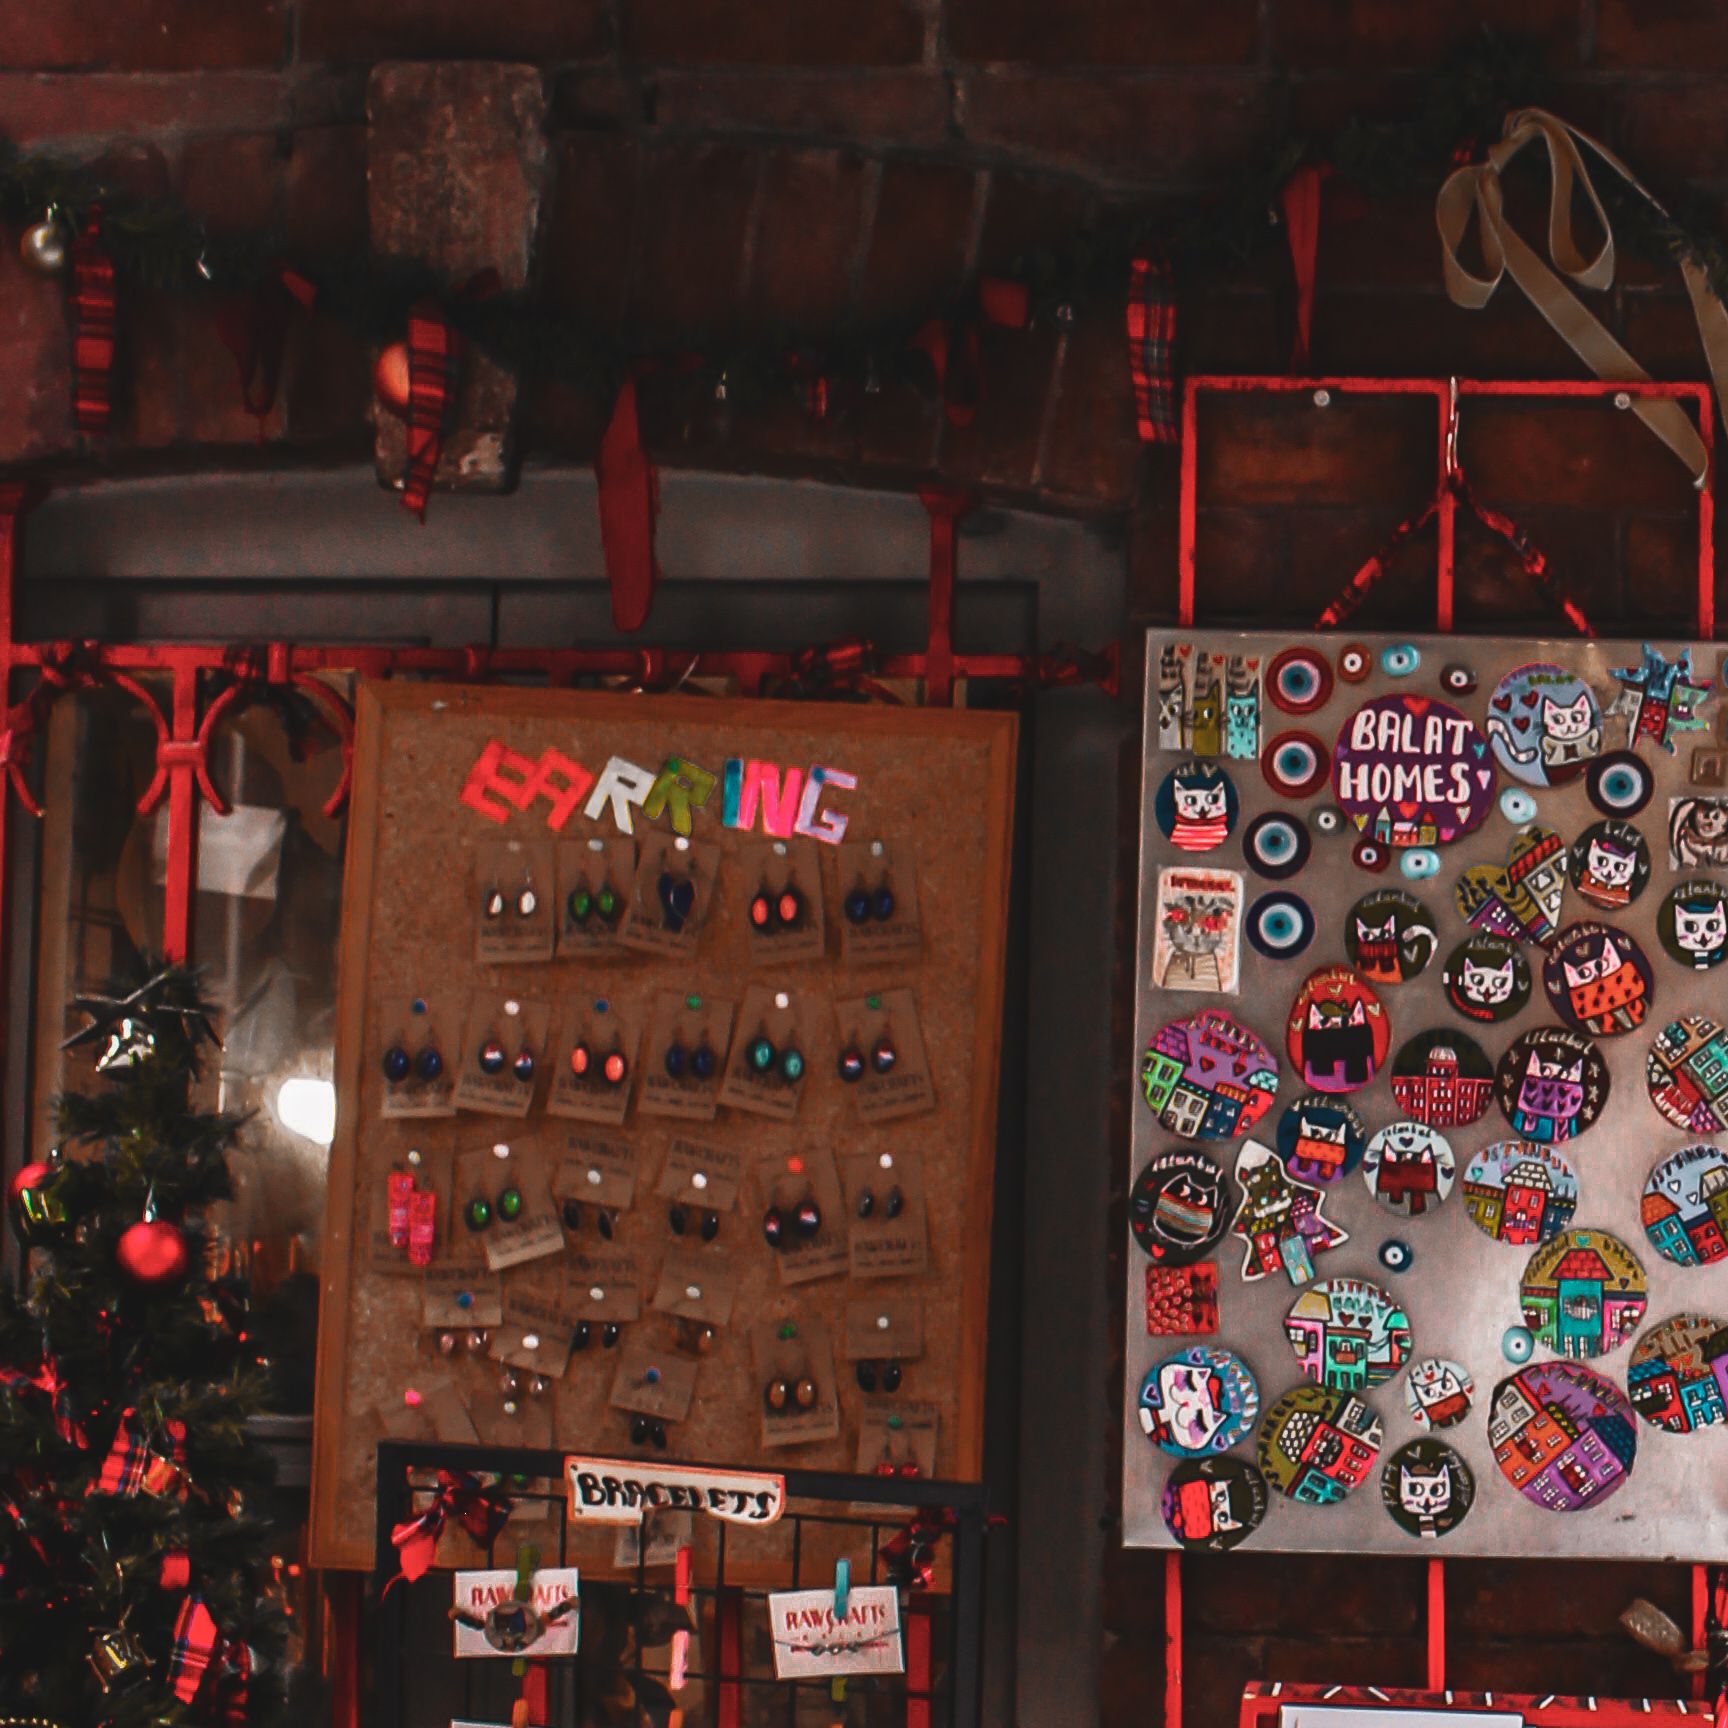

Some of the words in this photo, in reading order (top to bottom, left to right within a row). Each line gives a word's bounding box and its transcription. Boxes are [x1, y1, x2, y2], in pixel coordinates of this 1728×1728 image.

[1348, 707, 1474, 756] BALAT
[458, 736, 859, 846] EARRING
[1339, 762, 1473, 806] HOMES
[576, 1471, 778, 1522] BRACELETS
